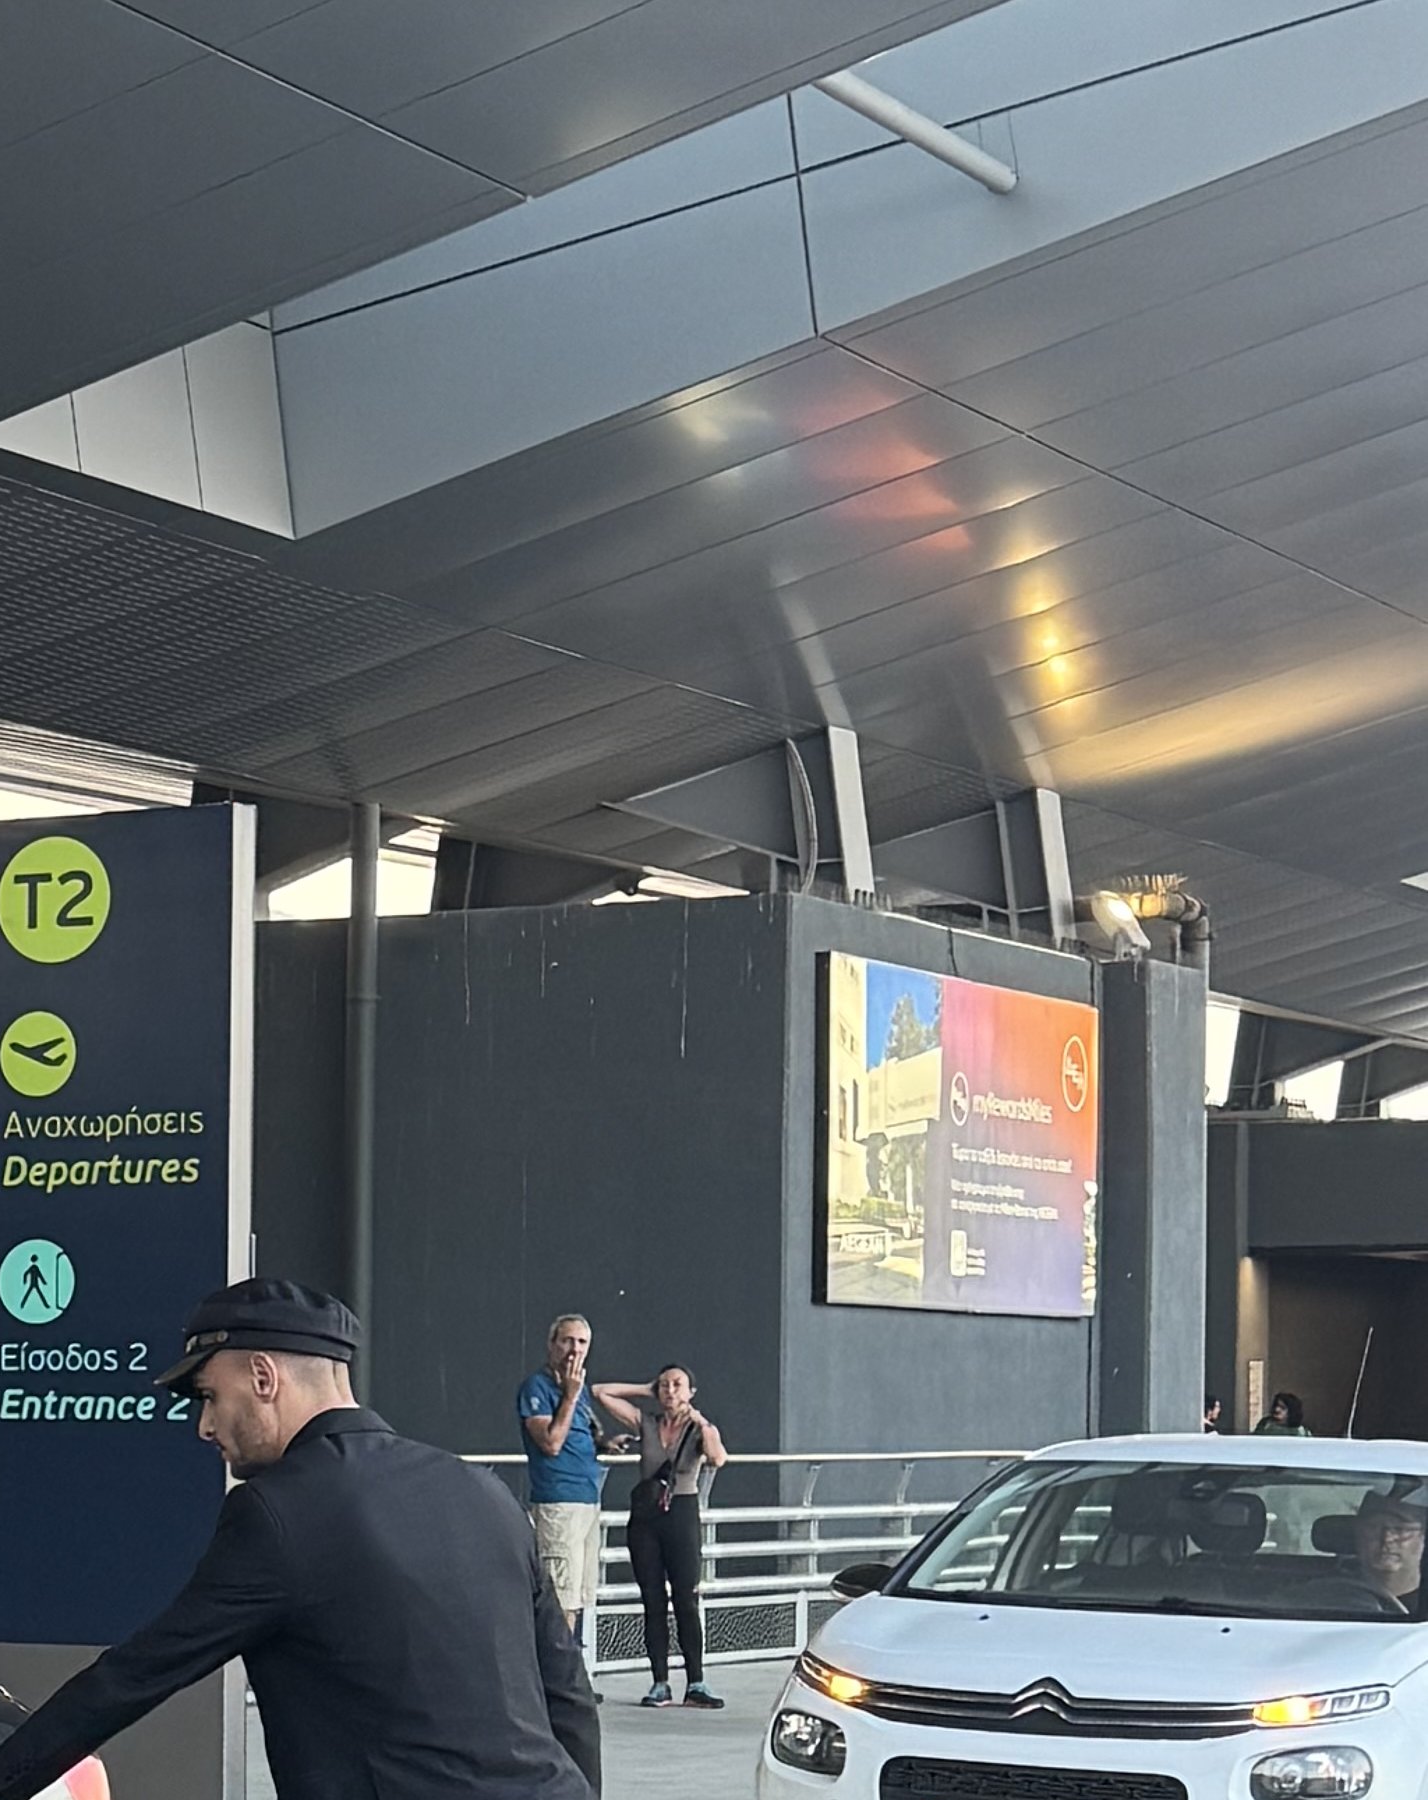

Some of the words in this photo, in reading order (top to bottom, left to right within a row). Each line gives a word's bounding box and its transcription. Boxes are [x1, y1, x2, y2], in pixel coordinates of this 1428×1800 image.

[13, 870, 94, 929] T2
[3, 1105, 205, 1143] Αναχωρήσεις
[2, 1154, 201, 1194] Departures
[0, 1341, 119, 1372] Είσοδος
[127, 1342, 149, 1372] 2
[0, 1388, 157, 1421] Entrance
